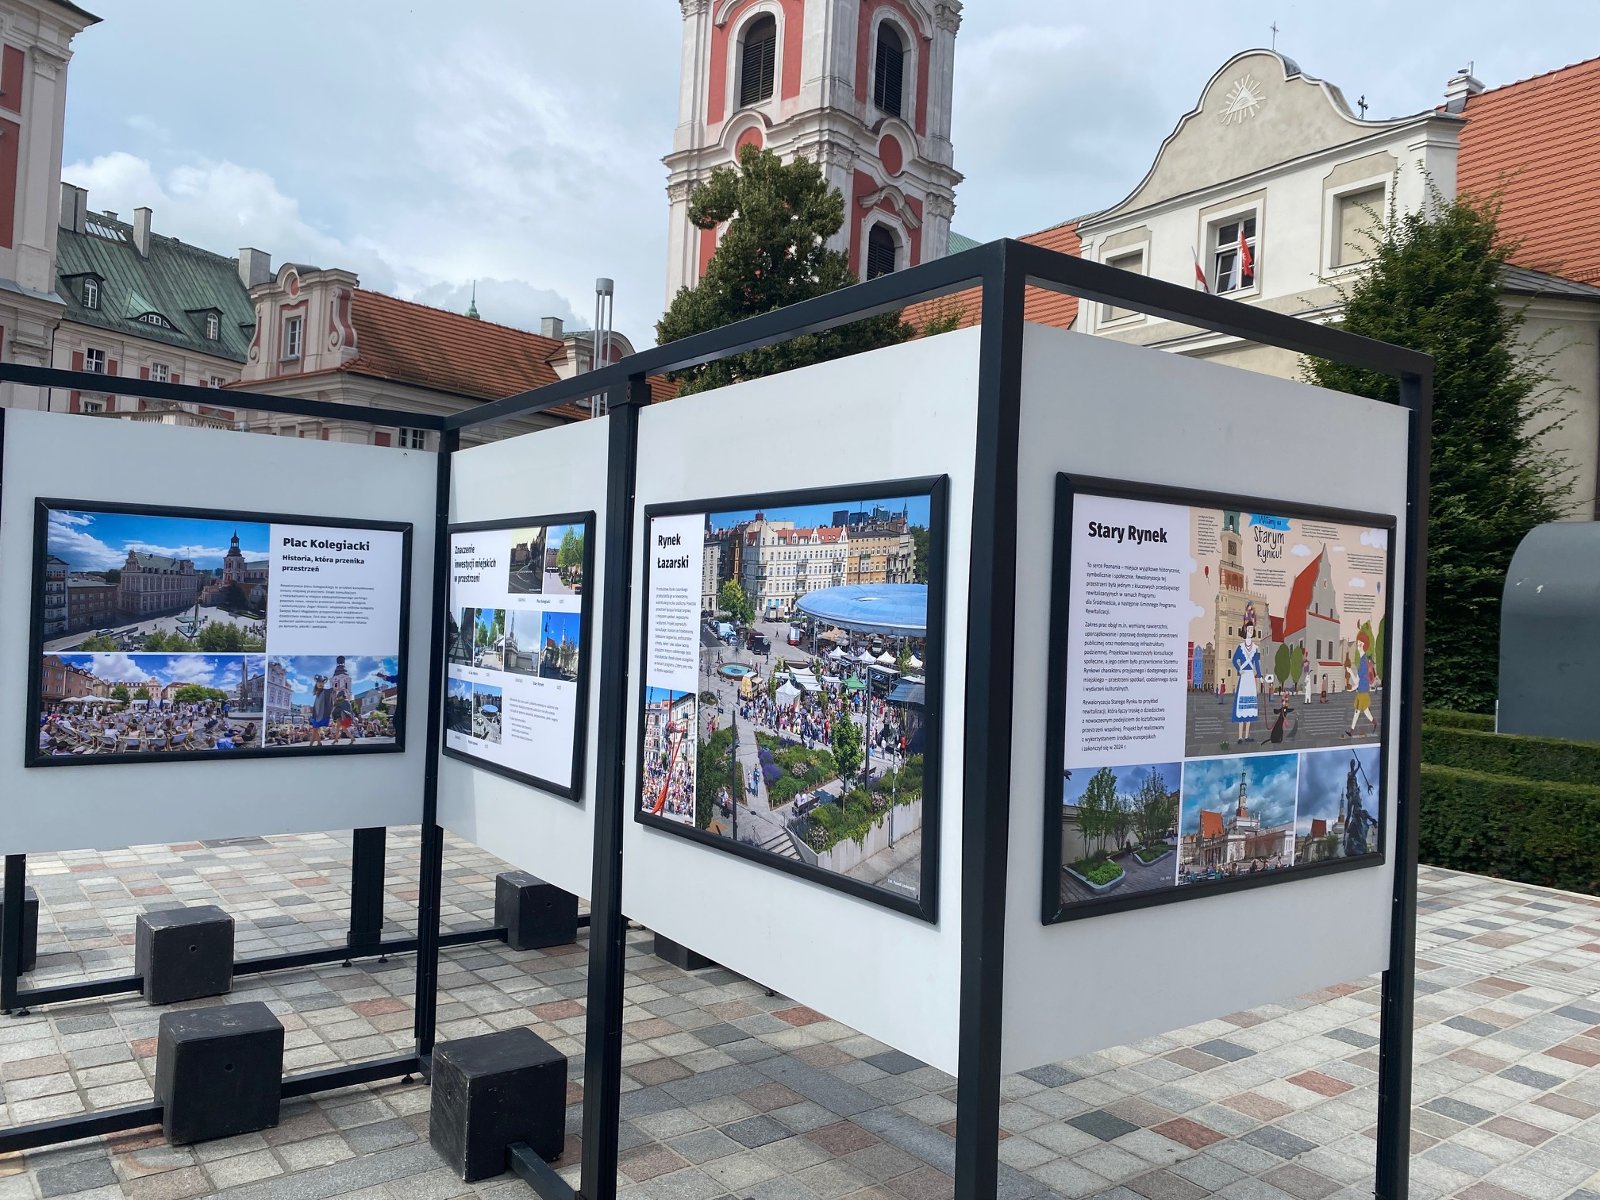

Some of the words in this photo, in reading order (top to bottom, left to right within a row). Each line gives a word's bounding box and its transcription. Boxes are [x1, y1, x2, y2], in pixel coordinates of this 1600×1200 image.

[1088, 521, 1125, 543] Stary
[1128, 525, 1168, 545] Rynek
[1254, 526, 1285, 550] Starym
[283, 537, 308, 548] Plac
[310, 538, 370, 551] Kolegiacki
[658, 533, 681, 549] Rynek
[454, 543, 475, 554] Znaczenie
[1257, 544, 1282, 563] Rynku!
[282, 554, 314, 563] Historia,
[315, 555, 333, 563] która
[335, 556, 365, 565] przenika
[454, 557, 475, 570] inwestycji
[475, 557, 497, 570] miejskich
[657, 555, 689, 569] Łazarski
[282, 564, 320, 573] przestrzeń
[458, 573, 481, 584] przestrzeni
